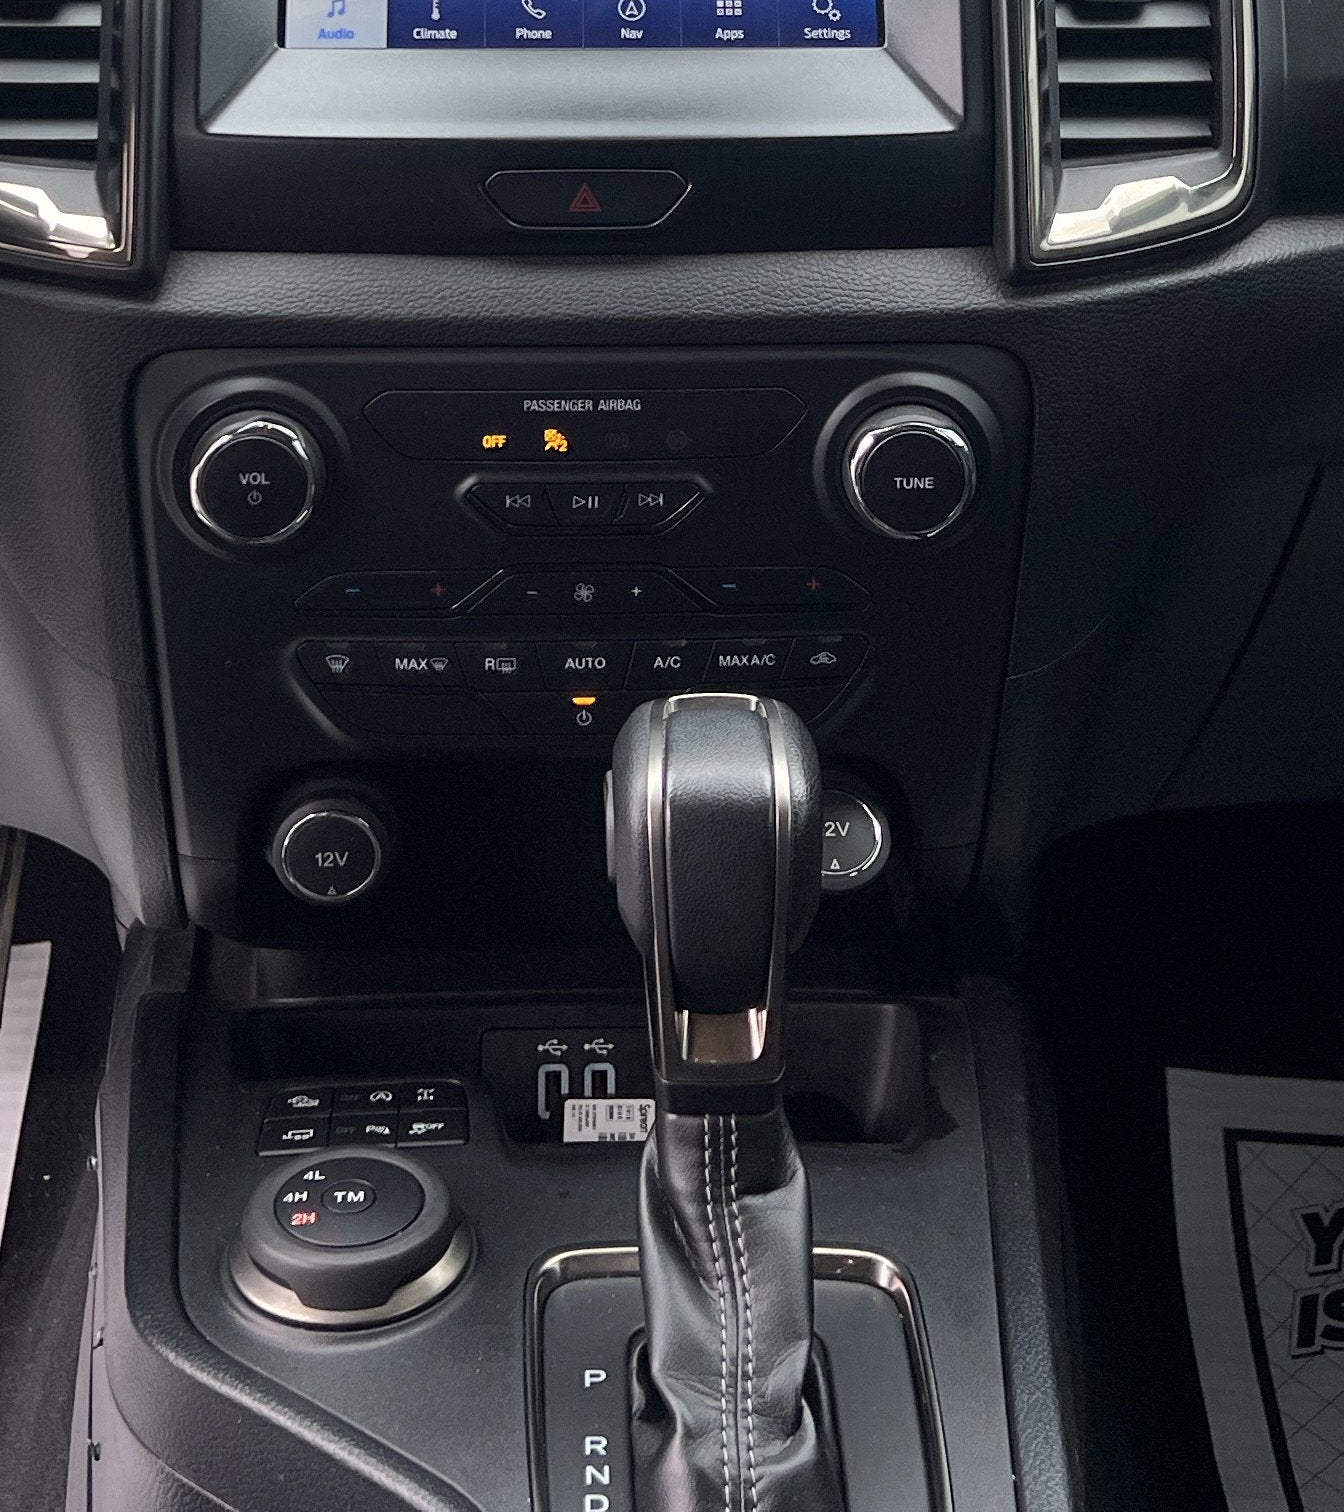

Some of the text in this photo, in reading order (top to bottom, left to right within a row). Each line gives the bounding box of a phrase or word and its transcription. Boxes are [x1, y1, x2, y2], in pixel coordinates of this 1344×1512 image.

[317, 28, 355, 40] Audio
[412, 28, 458, 40] Climate
[515, 28, 553, 40] Phone
[620, 28, 644, 39] Nav
[715, 28, 745, 41] Apps
[803, 28, 852, 41] Settings
[523, 399, 642, 412] PASSENGER AIRBAG
[482, 434, 507, 450] OFF
[238, 472, 271, 485] VOL
[893, 476, 935, 490] TUNE
[394, 657, 428, 671] MAX
[484, 658, 495, 670] R
[564, 657, 606, 670] AUTO
[653, 655, 682, 669] A/C
[718, 654, 750, 667] MAX
[824, 821, 850, 837] 2V
[315, 851, 349, 867] 12V
[303, 1170, 326, 1181] 4L
[283, 1191, 309, 1203] 4H
[334, 1190, 365, 1203] TM
[290, 1211, 317, 1226] 2H
[584, 1369, 607, 1388] P
[584, 1435, 608, 1456] R
[585, 1464, 610, 1486] N
[584, 1493, 610, 1512] D
